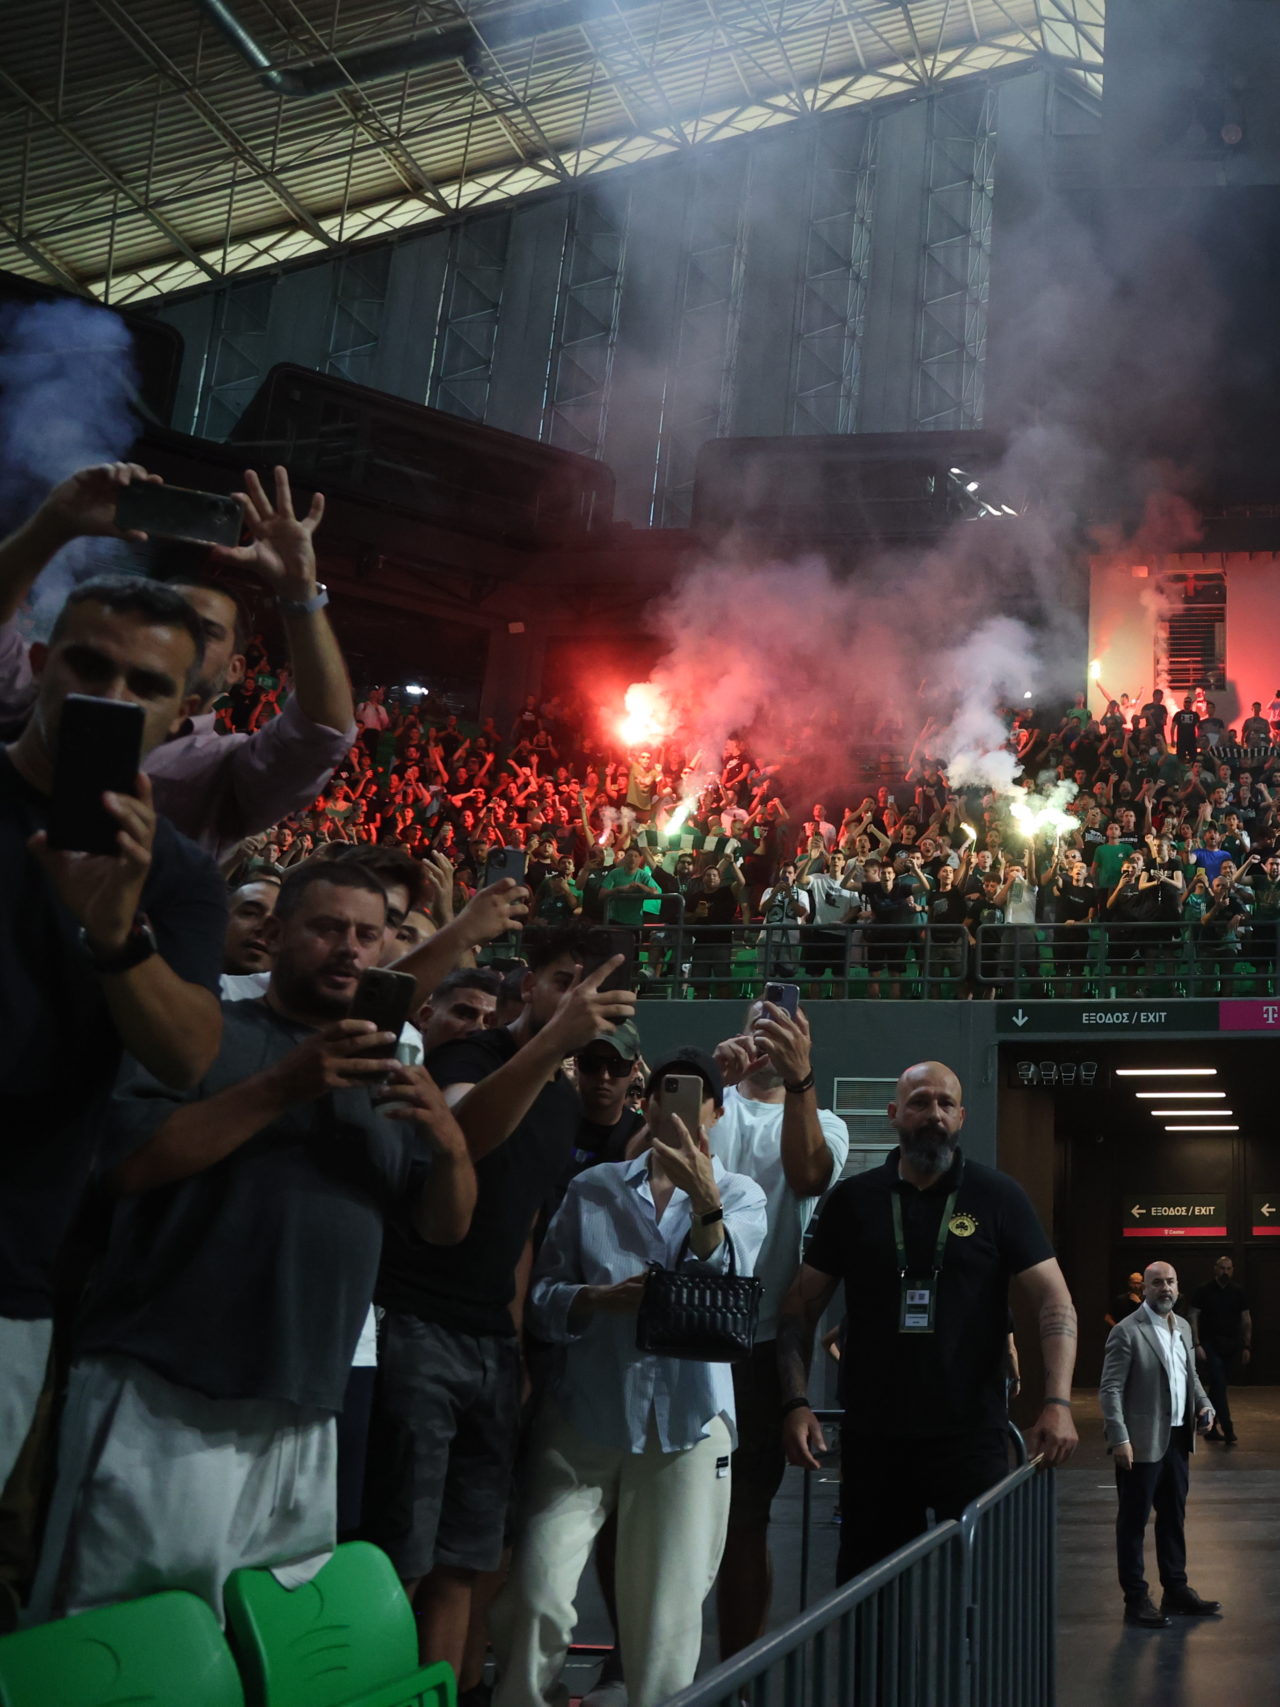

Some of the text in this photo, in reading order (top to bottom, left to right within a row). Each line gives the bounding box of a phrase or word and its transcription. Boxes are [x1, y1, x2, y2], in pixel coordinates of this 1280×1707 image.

[1082, 1012, 1130, 1024] ΕΞΟΔΟΣ
[1140, 1012, 1168, 1023] EXIT
[1151, 1206, 1188, 1216] ΕΞΟΔΟΣ
[1194, 1206, 1216, 1215] EXIT
